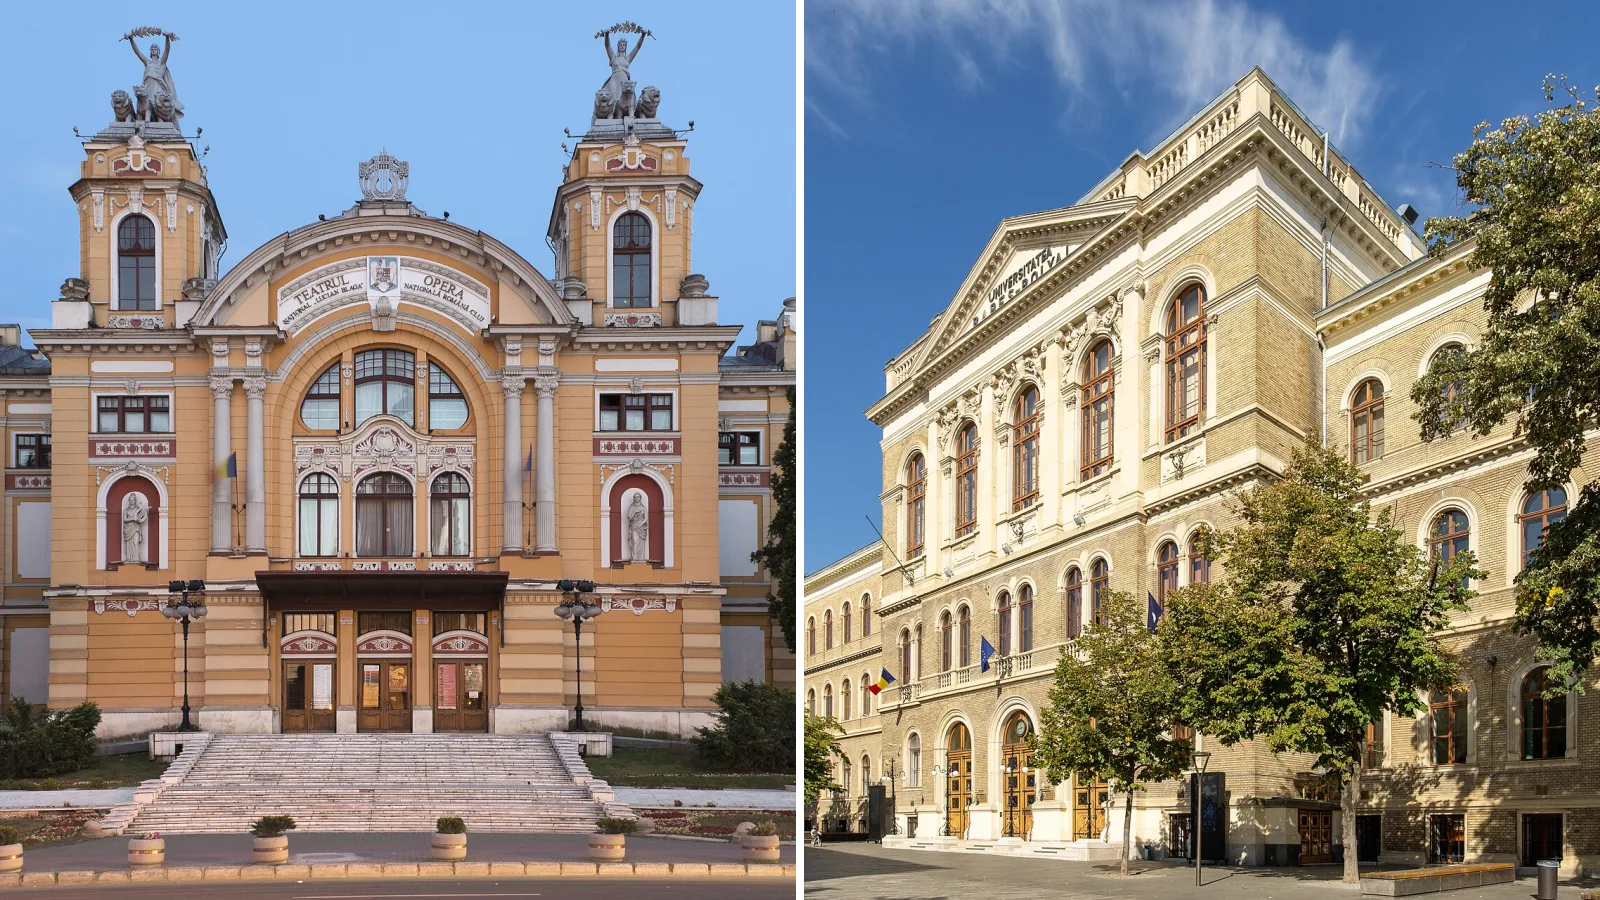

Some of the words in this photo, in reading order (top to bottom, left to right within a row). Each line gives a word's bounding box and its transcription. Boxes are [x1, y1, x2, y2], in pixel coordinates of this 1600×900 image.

[293, 275, 350, 305] TEATRUL
[423, 275, 465, 301] OPERA
[988, 247, 1053, 303] UNIVERSITATEA
